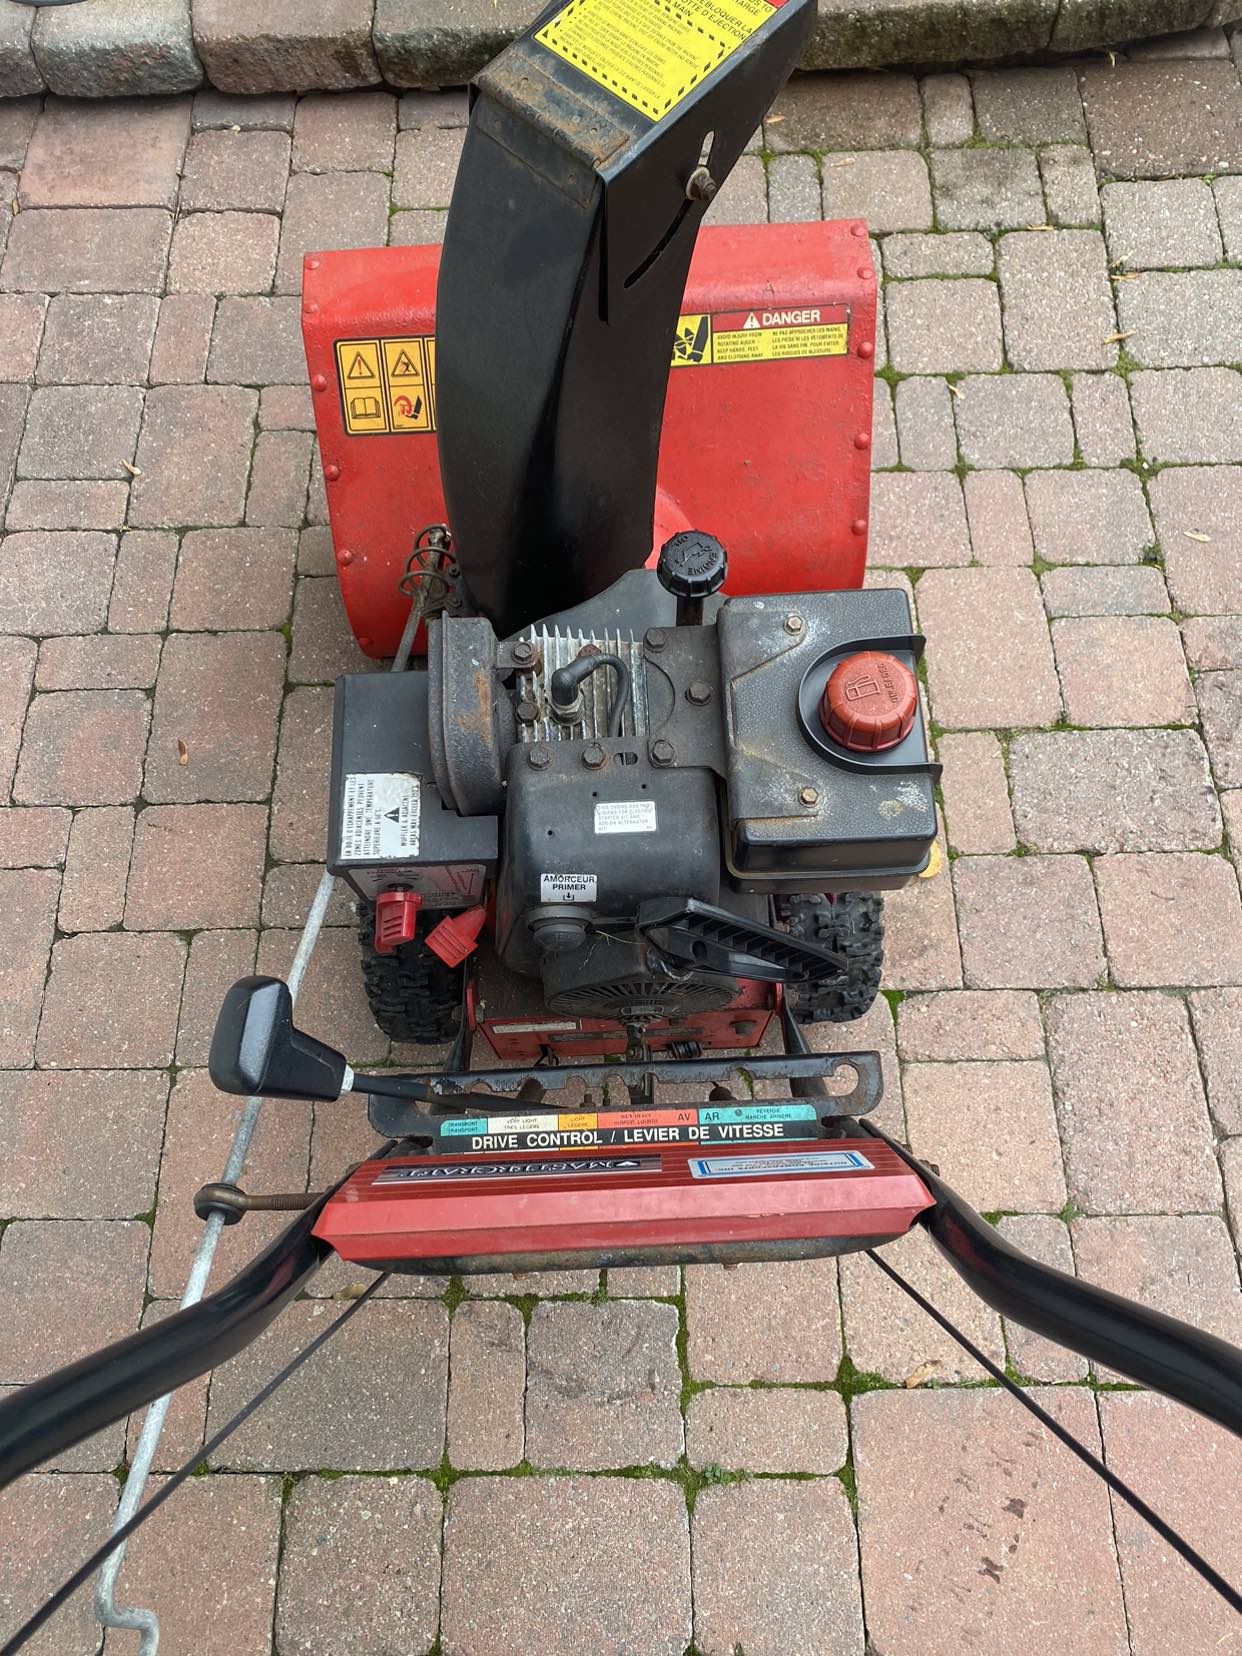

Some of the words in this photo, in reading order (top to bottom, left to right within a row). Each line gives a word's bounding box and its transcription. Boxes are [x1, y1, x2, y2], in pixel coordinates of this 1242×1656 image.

[671, 1, 694, 17] MAIN
[760, 3, 773, 13] TO
[762, 310, 821, 326] DANGER
[543, 875, 595, 883] AMORCEUR
[677, 1112, 691, 1121] AV
[704, 1111, 720, 1121] AR
[472, 1134, 519, 1150] DRIVE
[526, 1131, 603, 1147] CONTROL
[624, 1127, 680, 1143] LEVIER
[688, 1126, 710, 1140] DE
[718, 1123, 784, 1139] VITESSE
